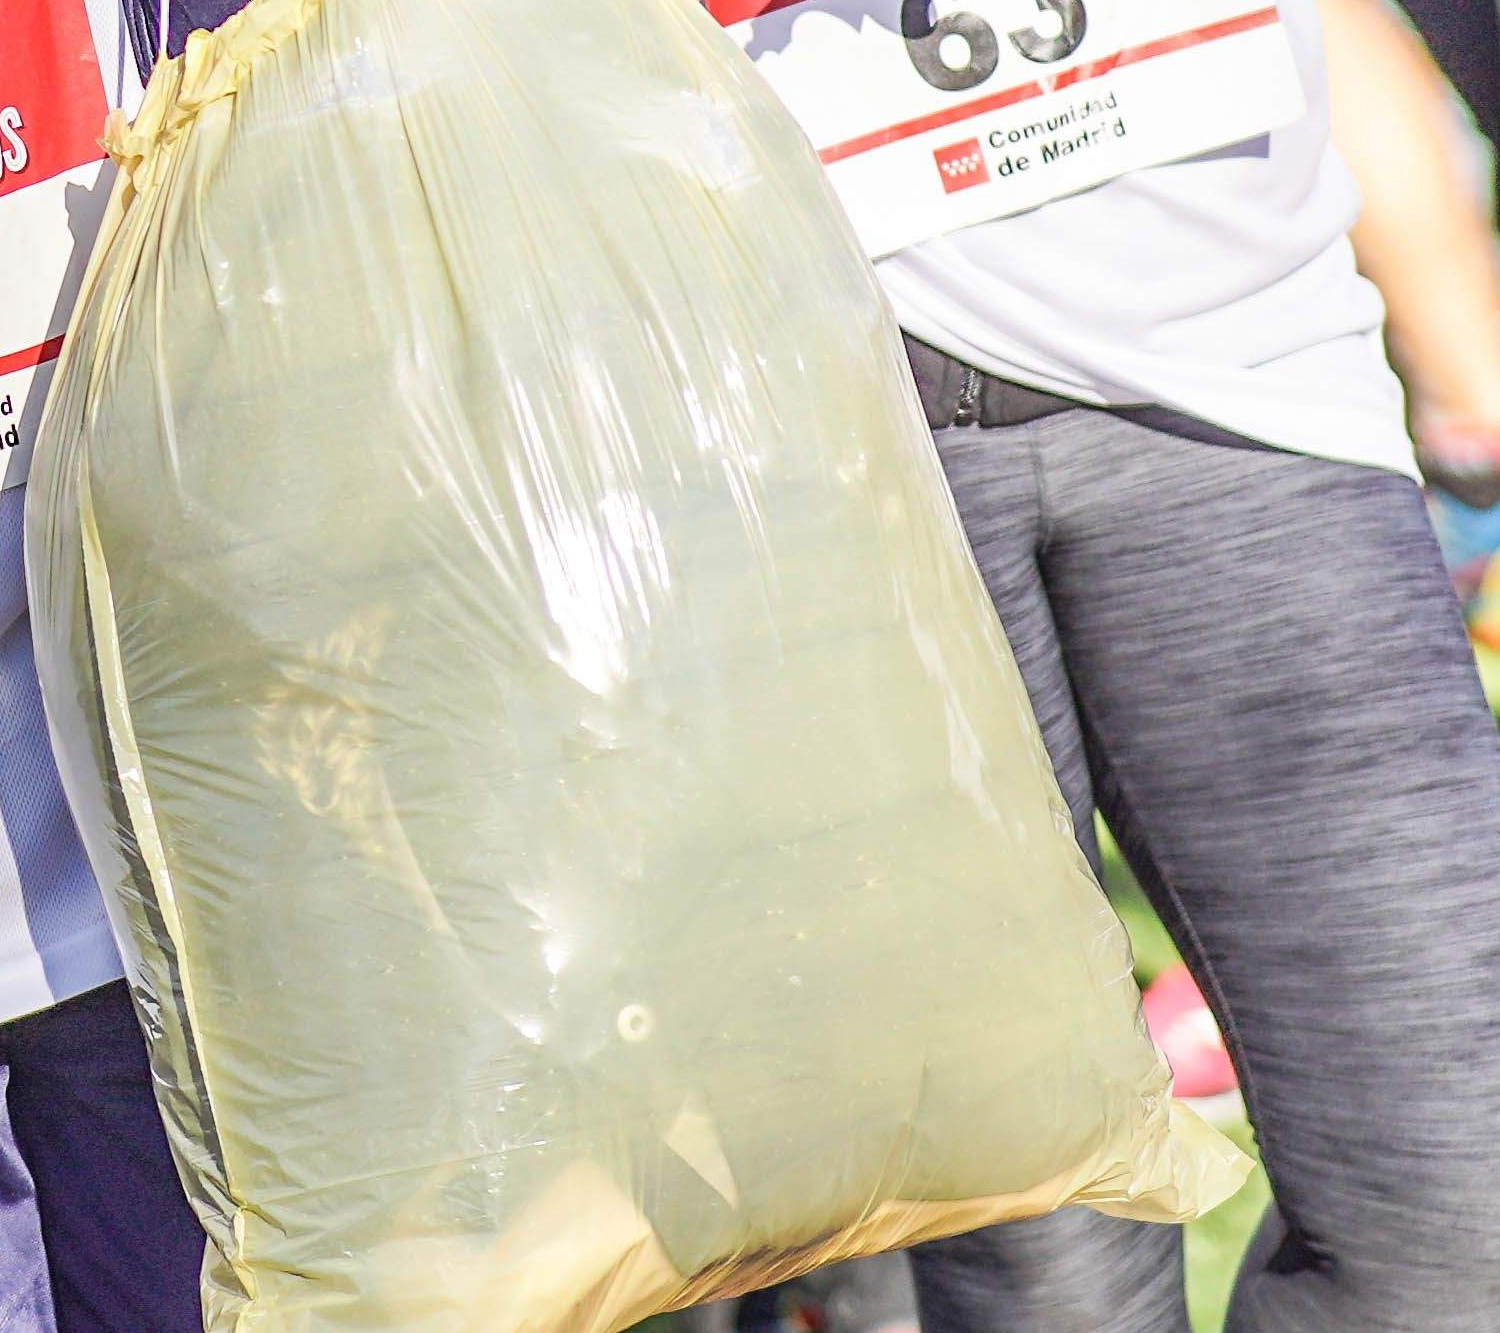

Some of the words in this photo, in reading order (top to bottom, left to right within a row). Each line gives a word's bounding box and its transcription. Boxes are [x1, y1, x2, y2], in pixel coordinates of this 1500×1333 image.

[988, 91, 1118, 149] Comunidad
[997, 157, 1031, 177] de
[1042, 117, 1128, 165] Madrid
